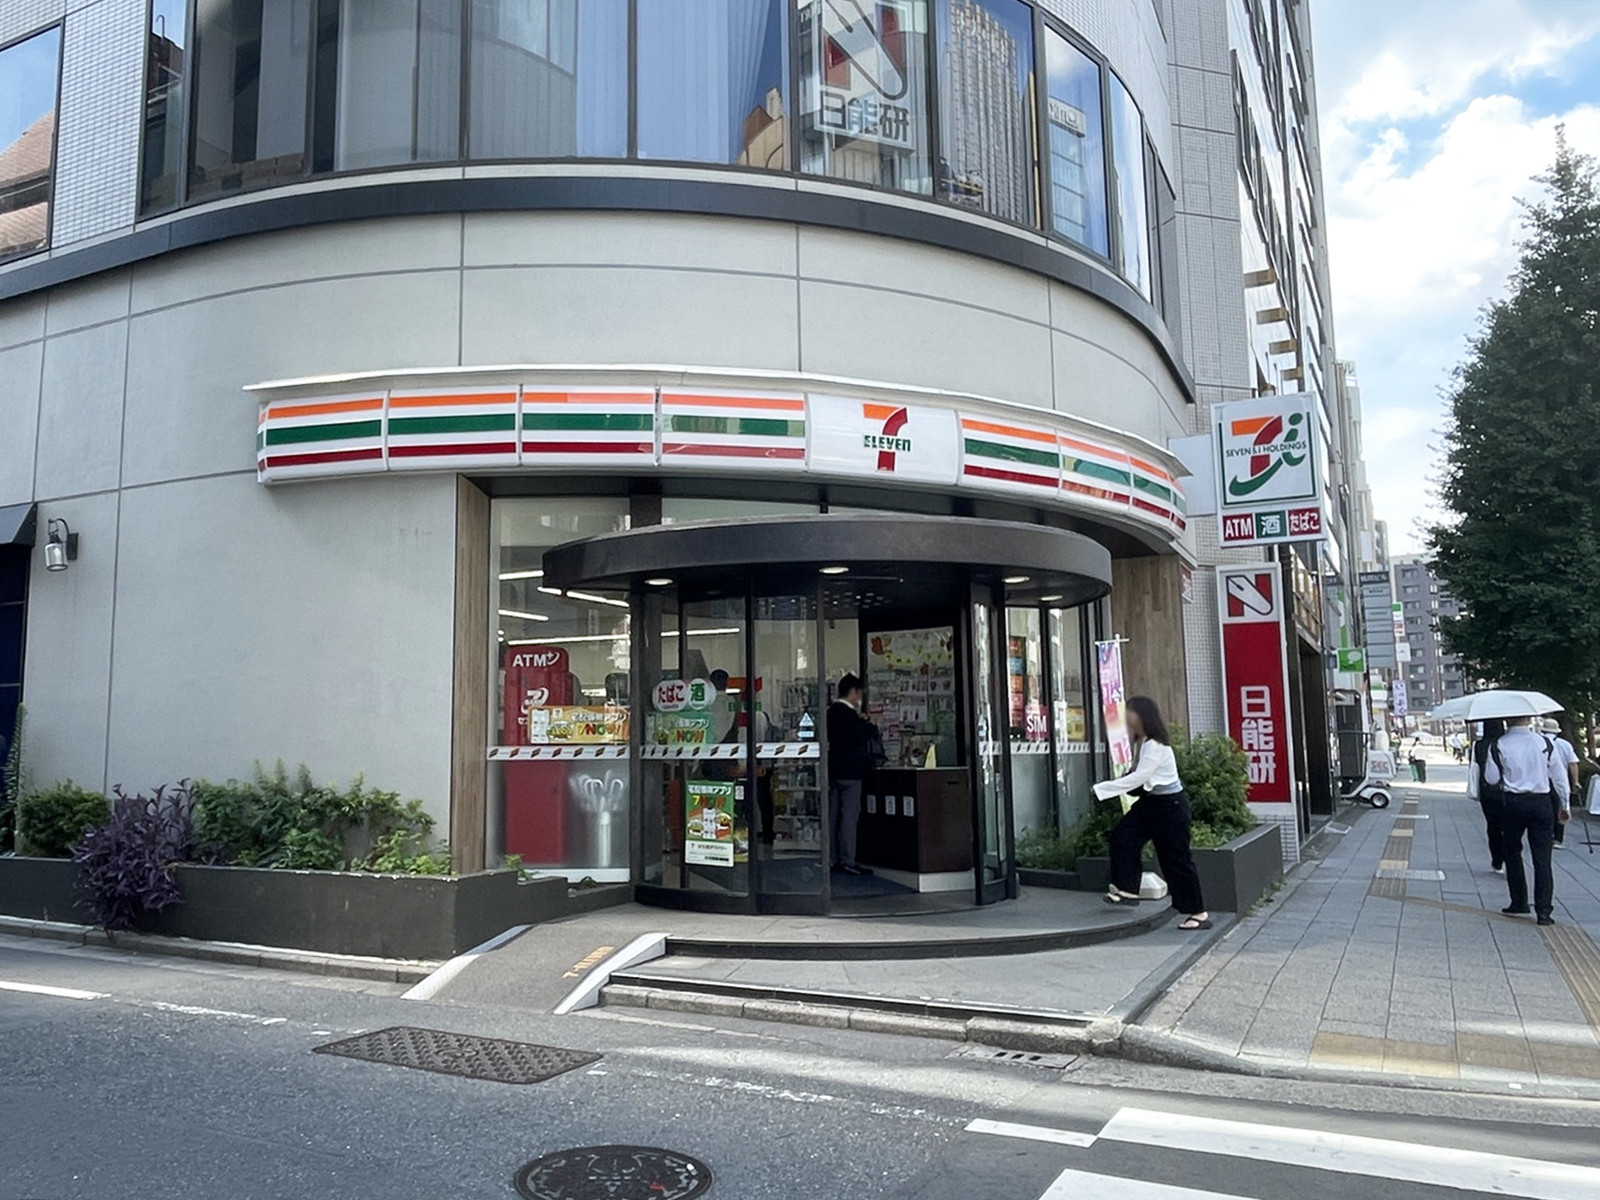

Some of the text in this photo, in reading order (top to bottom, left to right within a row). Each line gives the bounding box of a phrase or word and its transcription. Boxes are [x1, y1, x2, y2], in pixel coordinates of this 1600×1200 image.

[1264, 440, 1307, 454] HOLDINGS
[1225, 517, 1253, 538] ATM
[1261, 515, 1281, 535] 酒
[1289, 513, 1320, 532] たばこ
[513, 654, 547, 668] ATM
[658, 684, 685, 704] たばこ
[690, 683, 705, 702] 酒
[1027, 715, 1047, 732] SIM
[1241, 685, 1276, 784] 日能研
